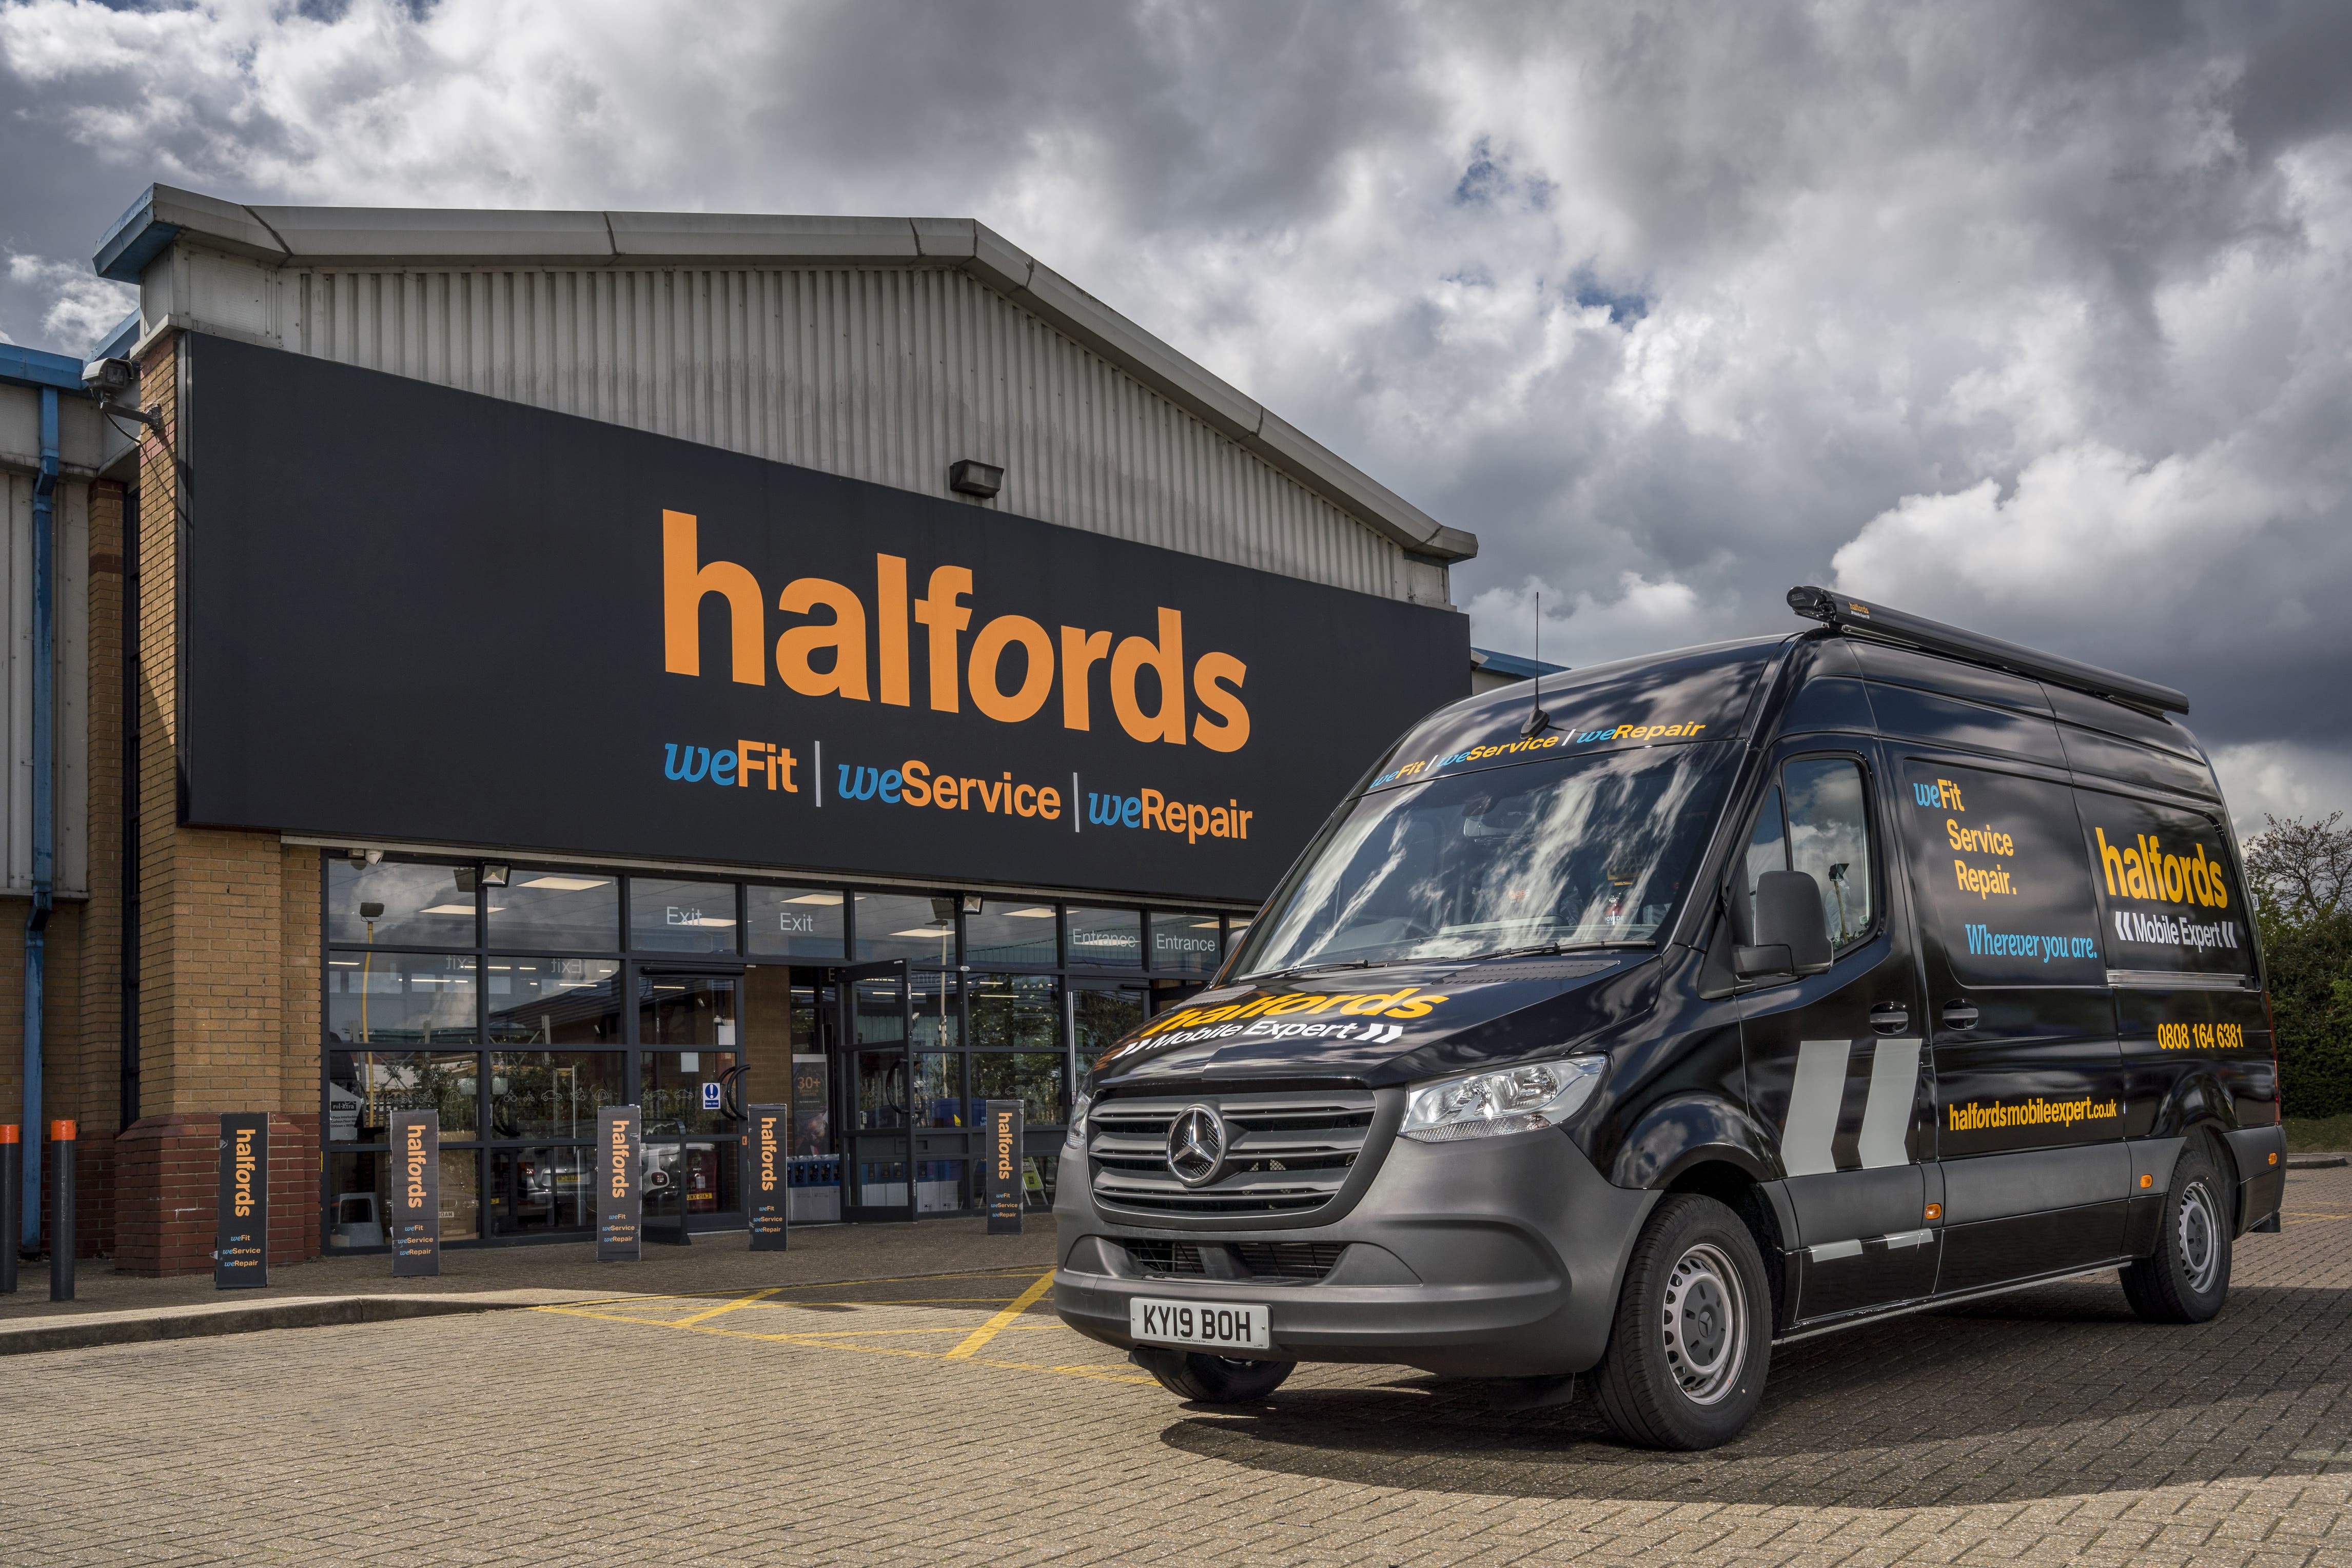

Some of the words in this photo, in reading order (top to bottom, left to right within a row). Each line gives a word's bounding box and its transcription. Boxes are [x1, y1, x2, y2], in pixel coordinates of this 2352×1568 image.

[1849, 602, 1869, 614] halfords
[663, 509, 1250, 753] halfords
[1369, 760, 1426, 789] weFit
[1436, 735, 1559, 768] weService
[1576, 721, 1706, 744] weRepair
[665, 739, 798, 793] weFit
[838, 760, 1061, 820] weService
[1088, 788, 1253, 844] weRepair
[1913, 779, 1965, 811] weFit
[1947, 819, 2014, 856] Service
[1954, 859, 2017, 900] Repair.
[2095, 827, 2228, 908] halfords
[667, 906, 702, 926] Exit
[780, 912, 813, 932] Exit
[2132, 912, 2180, 947] Mobile
[2180, 916, 2223, 953] Expert
[1073, 928, 1135, 947] Entrance
[1157, 933, 1215, 951] Entrance
[1965, 924, 2040, 957] Wherever
[2041, 936, 2069, 964] you
[2071, 937, 2098, 959] are.
[1140, 988, 1449, 1037] halfords
[1146, 1024, 1240, 1050] Mobile
[1242, 1020, 1359, 1042] Expert
[2158, 1023, 2190, 1050] 0808
[2192, 1023, 2214, 1048] 164
[2217, 1023, 2244, 1048] 6381
[797, 1076, 821, 1089] 30+
[1949, 1096, 2117, 1131] halfordsmobileexpert.co.uk
[612, 1121, 630, 1198] halfords
[761, 1118, 777, 1191] halfords
[998, 1112, 1013, 1180] halfords
[235, 1129, 256, 1217] halfords
[407, 1125, 427, 1208] halfords
[1144, 1304, 1193, 1338] KY19
[1201, 1309, 1251, 1342] BOH
